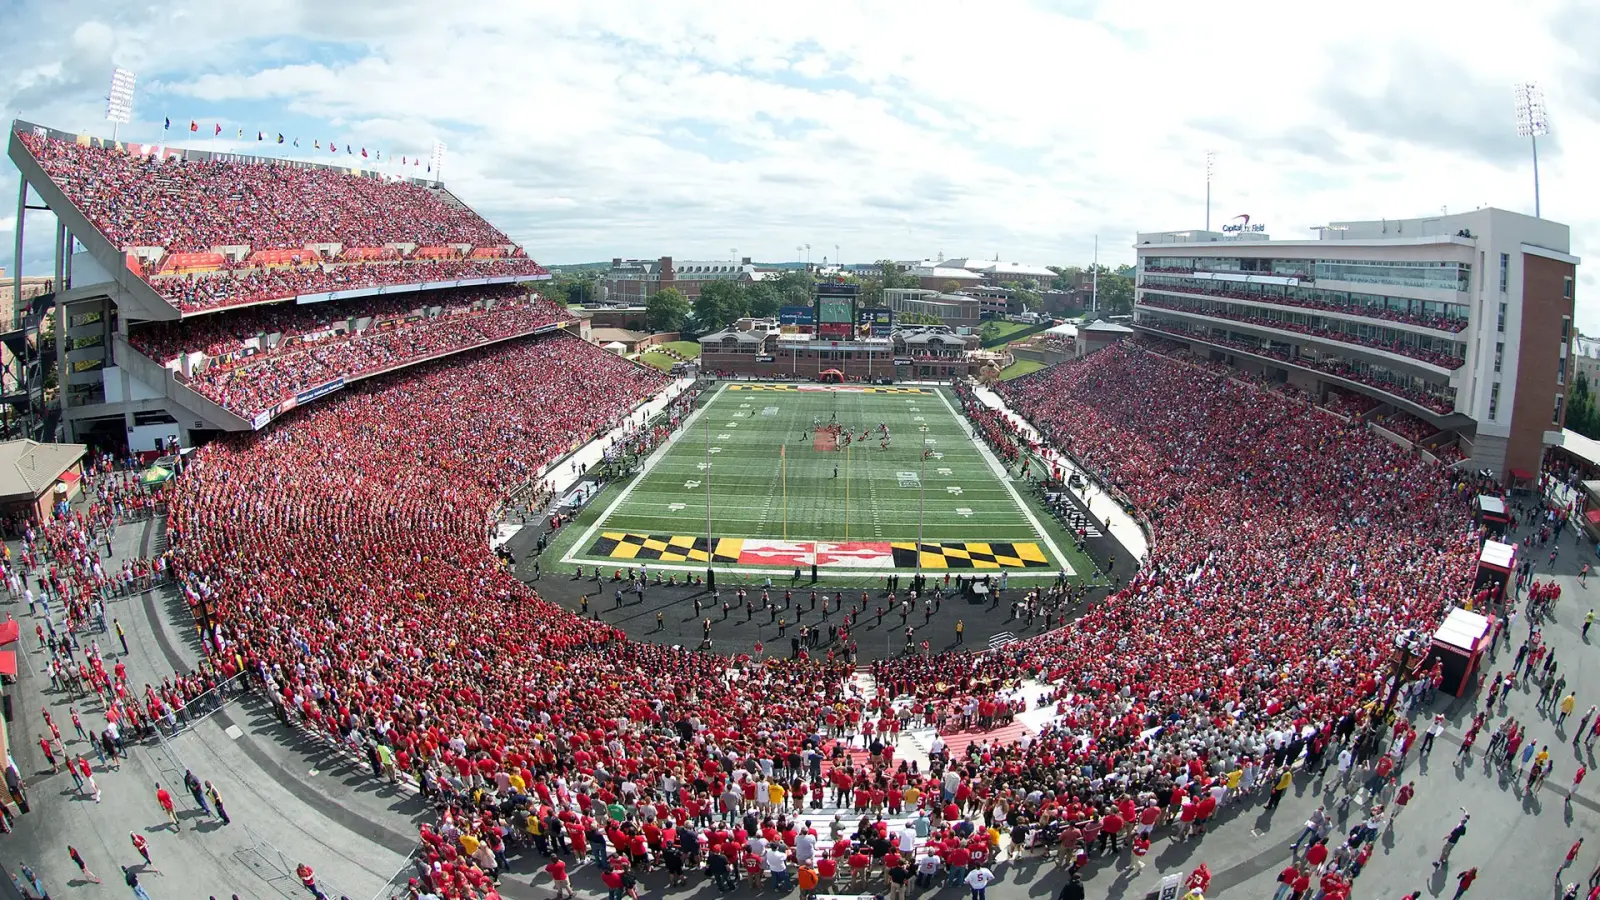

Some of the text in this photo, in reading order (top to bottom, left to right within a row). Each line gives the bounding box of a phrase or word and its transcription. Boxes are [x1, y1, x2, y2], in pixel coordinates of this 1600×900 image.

[916, 796, 923, 806] 5
[970, 851, 983, 859] 10
[977, 873, 984, 881] 5
